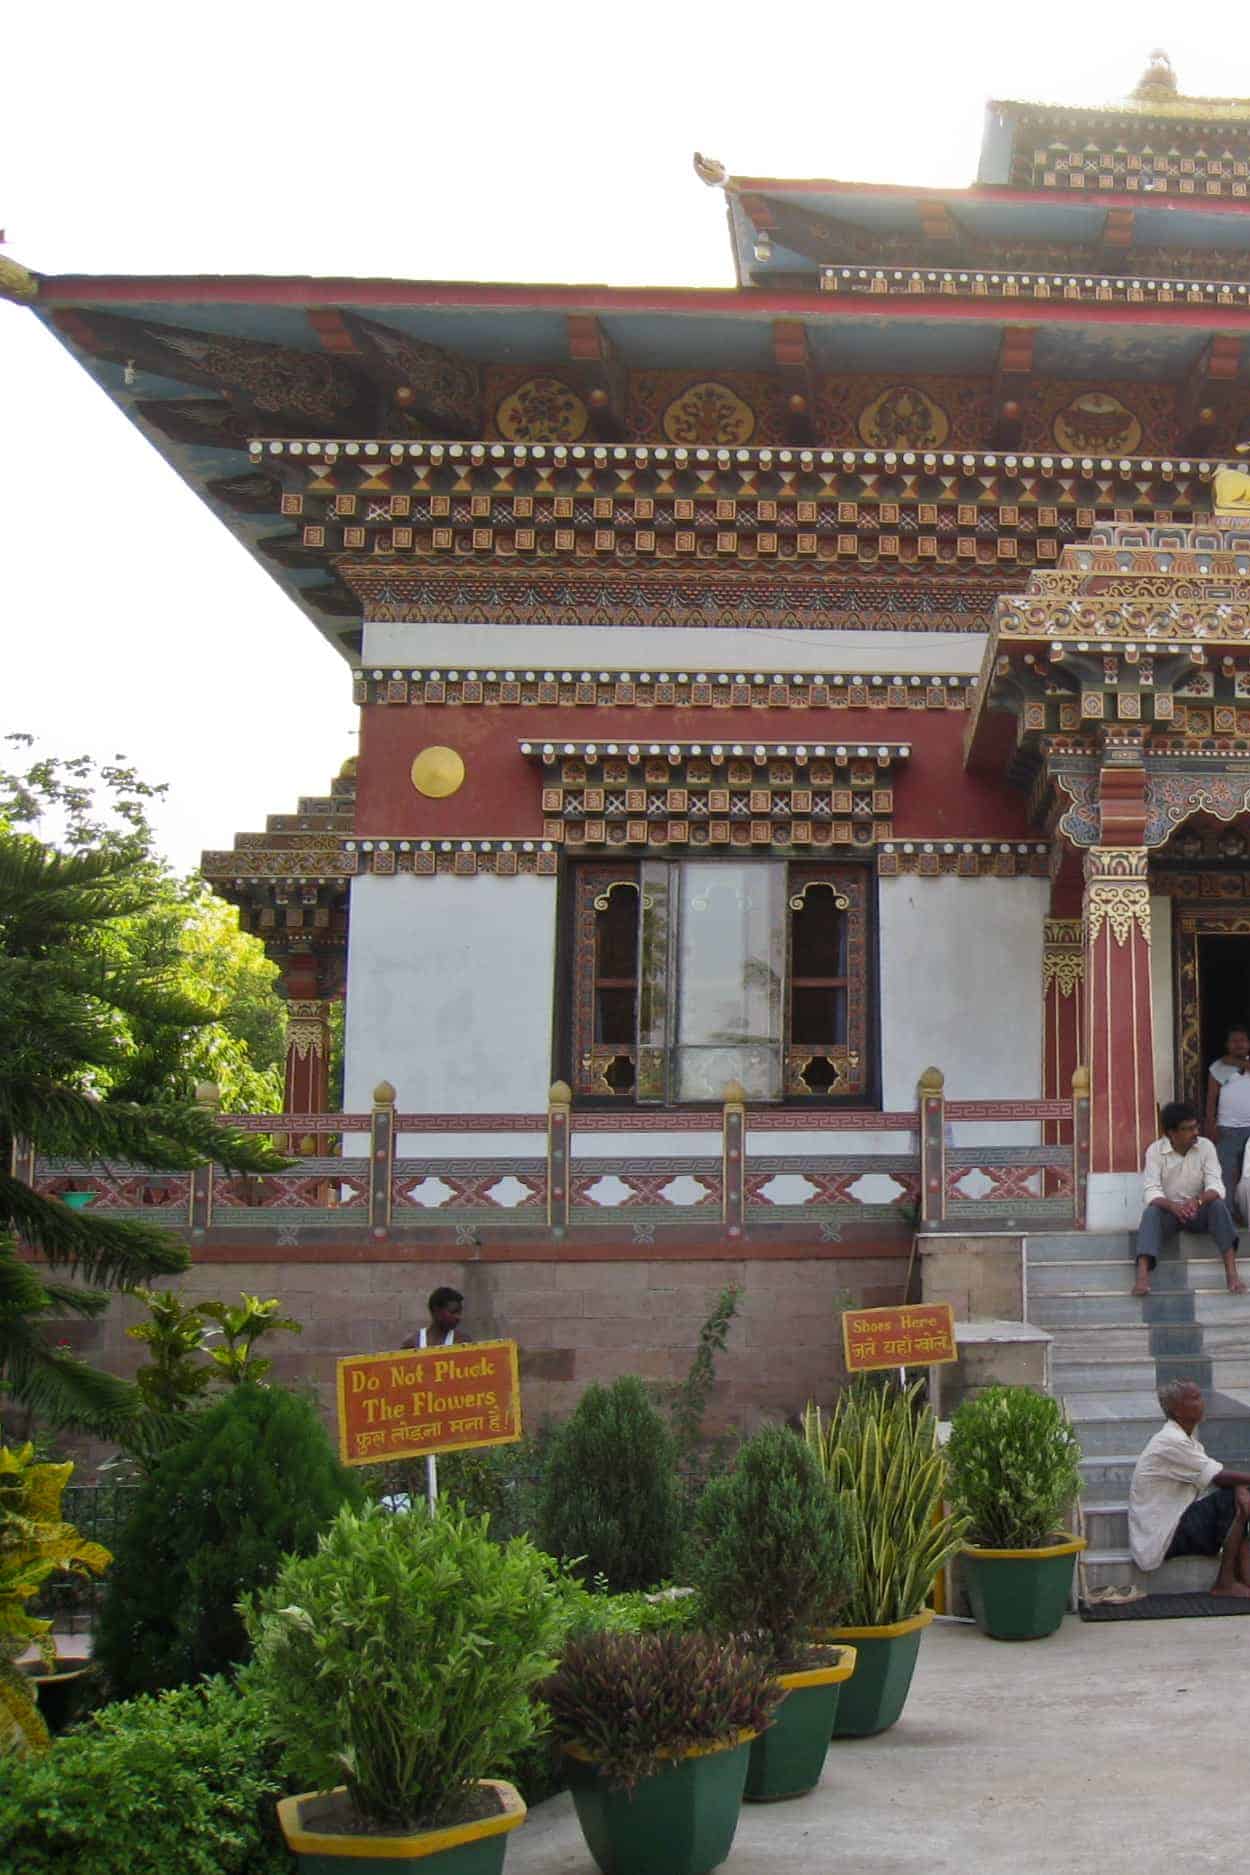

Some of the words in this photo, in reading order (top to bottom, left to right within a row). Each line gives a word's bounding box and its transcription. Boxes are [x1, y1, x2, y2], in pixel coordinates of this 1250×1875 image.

[853, 1319, 892, 1333] Shoes
[901, 1314, 937, 1329] Here
[351, 1370, 380, 1393] Do
[391, 1363, 424, 1387] Not
[434, 1357, 496, 1383] Pluck
[362, 1399, 406, 1424] The
[412, 1391, 497, 1416] Flowers
[448, 1416, 484, 1433] मना
